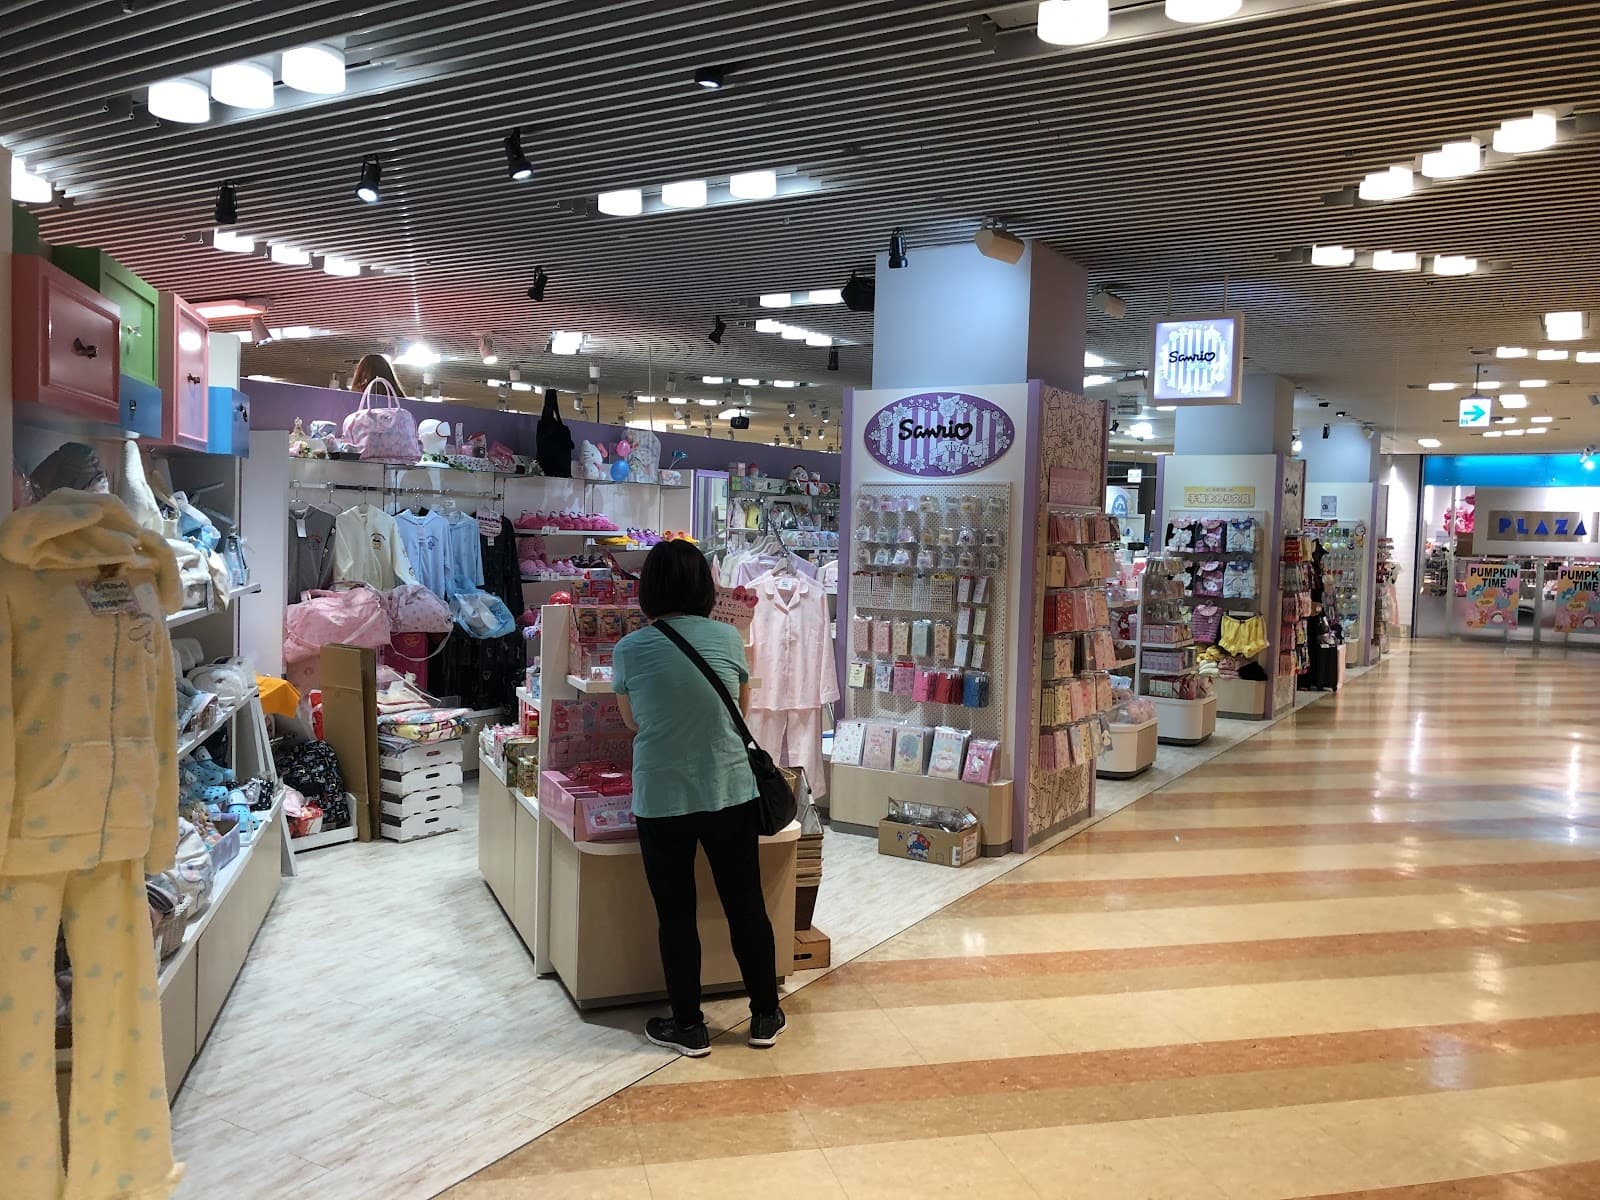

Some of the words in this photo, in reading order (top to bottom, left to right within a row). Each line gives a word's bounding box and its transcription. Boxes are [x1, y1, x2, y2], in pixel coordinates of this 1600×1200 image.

[1169, 350, 1216, 363] Sanrio
[899, 419, 973, 440] Sanrio
[1499, 518, 1587, 535] PLAZA
[1470, 567, 1518, 578] PUMPKIN
[1560, 569, 1600, 581] PUMPK
[1482, 577, 1507, 588] TIME
[1573, 581, 1599, 591] TIME
